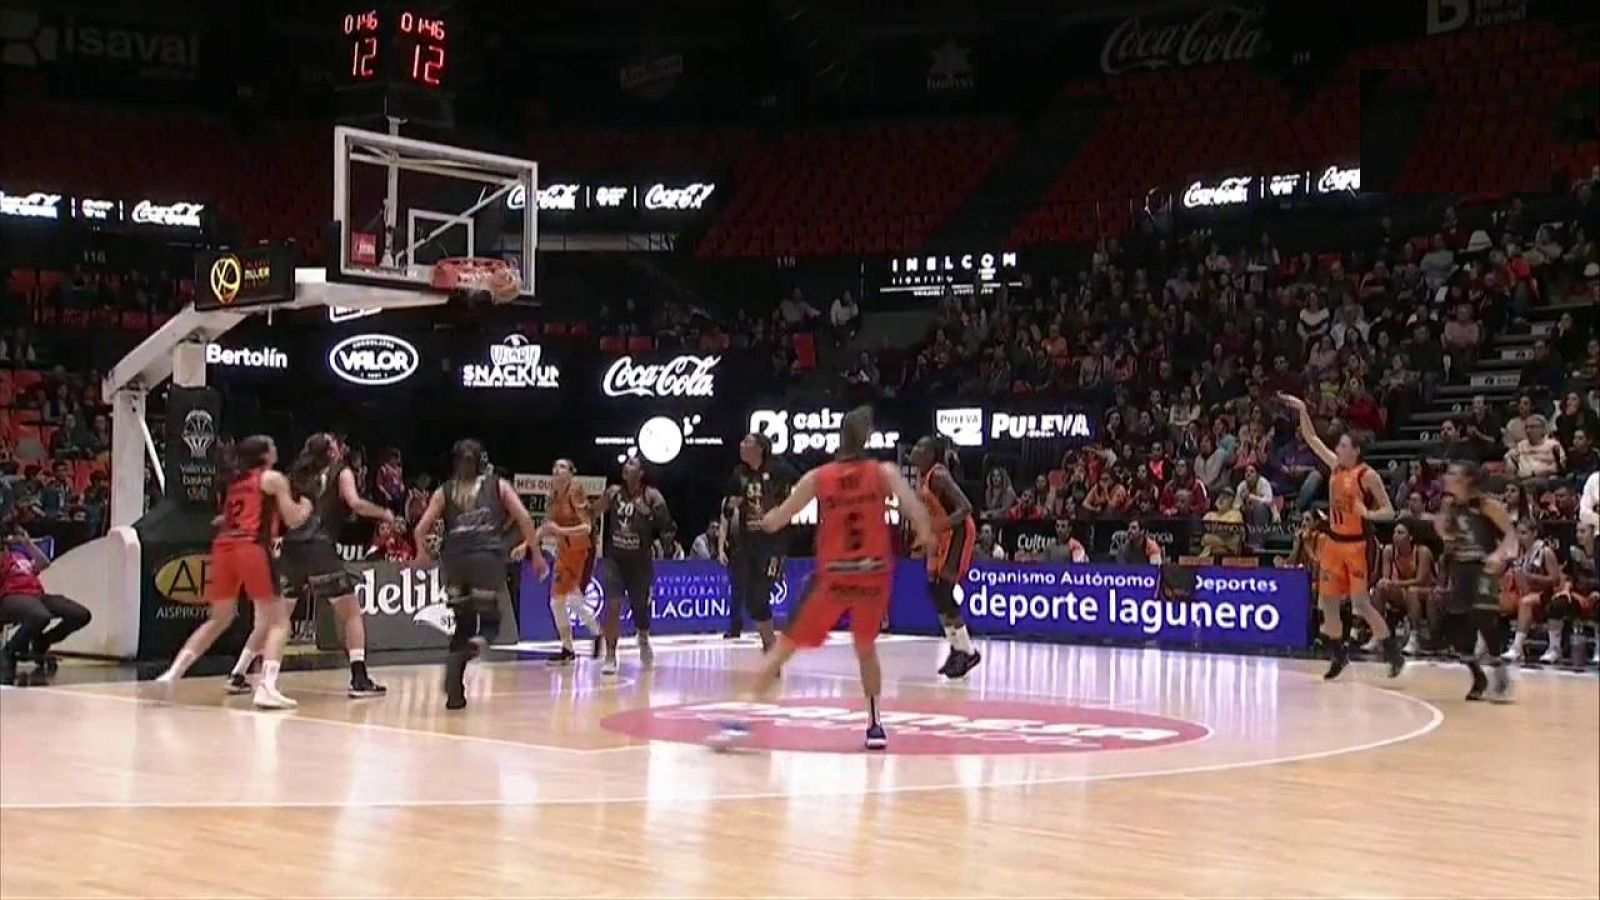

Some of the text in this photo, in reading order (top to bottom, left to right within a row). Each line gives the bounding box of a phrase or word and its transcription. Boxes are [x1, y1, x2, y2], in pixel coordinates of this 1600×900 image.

[63, 16, 200, 65] isaval
[352, 37, 377, 76] 12
[413, 44, 445, 84] 12
[206, 343, 288, 368] Bertolín
[339, 350, 409, 371] VALOR
[603, 355, 722, 397] Coca-Cola
[968, 568, 1056, 586] Organismo
[1060, 570, 1156, 588] Autónomo
[969, 584, 1280, 635] deporte lagunero
